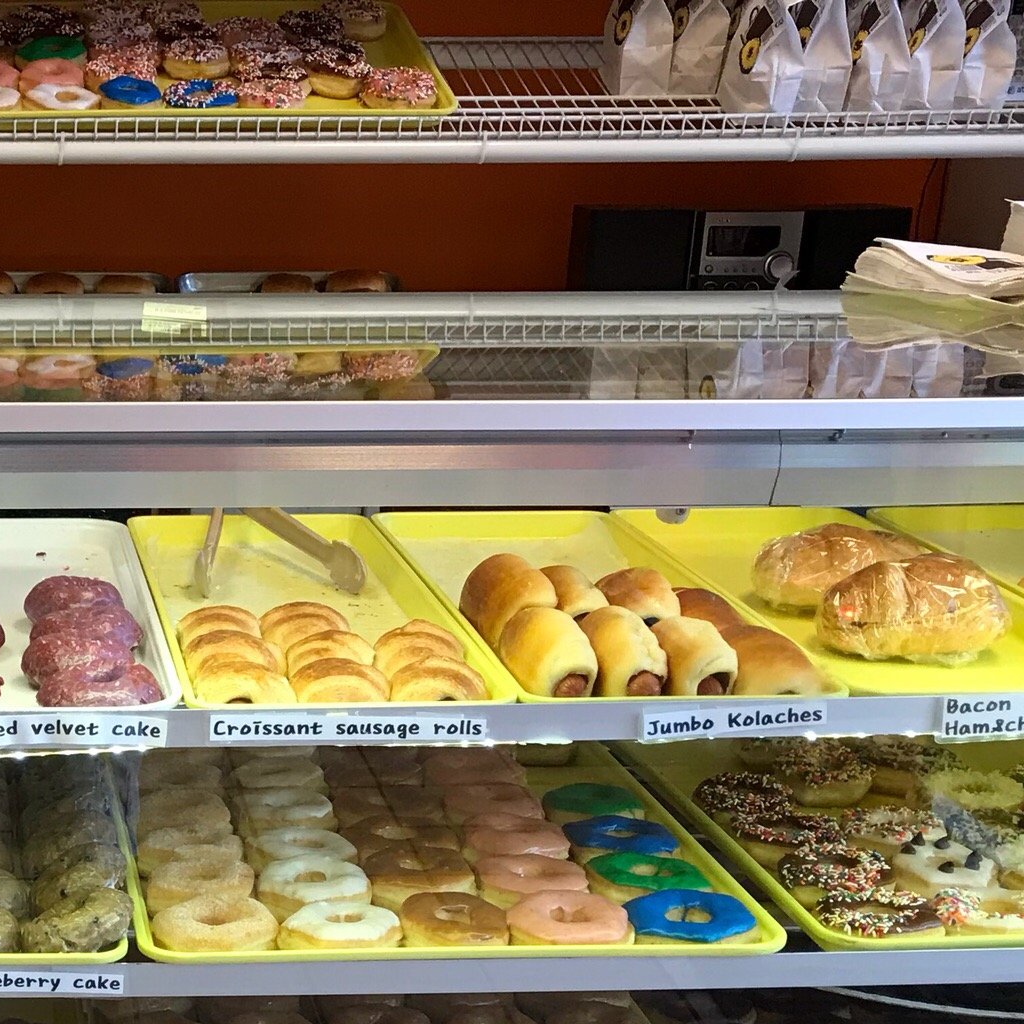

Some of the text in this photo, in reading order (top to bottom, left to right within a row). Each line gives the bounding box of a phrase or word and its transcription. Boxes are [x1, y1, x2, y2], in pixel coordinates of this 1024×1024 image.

[946, 698, 1011, 714] Bacon
[31, 719, 99, 736] velvet
[111, 721, 161, 738] cake
[335, 722, 420, 739] sausage
[433, 719, 482, 736] rolls
[647, 707, 823, 736] Jumbo Kolaches
[72, 975, 121, 990] cake
